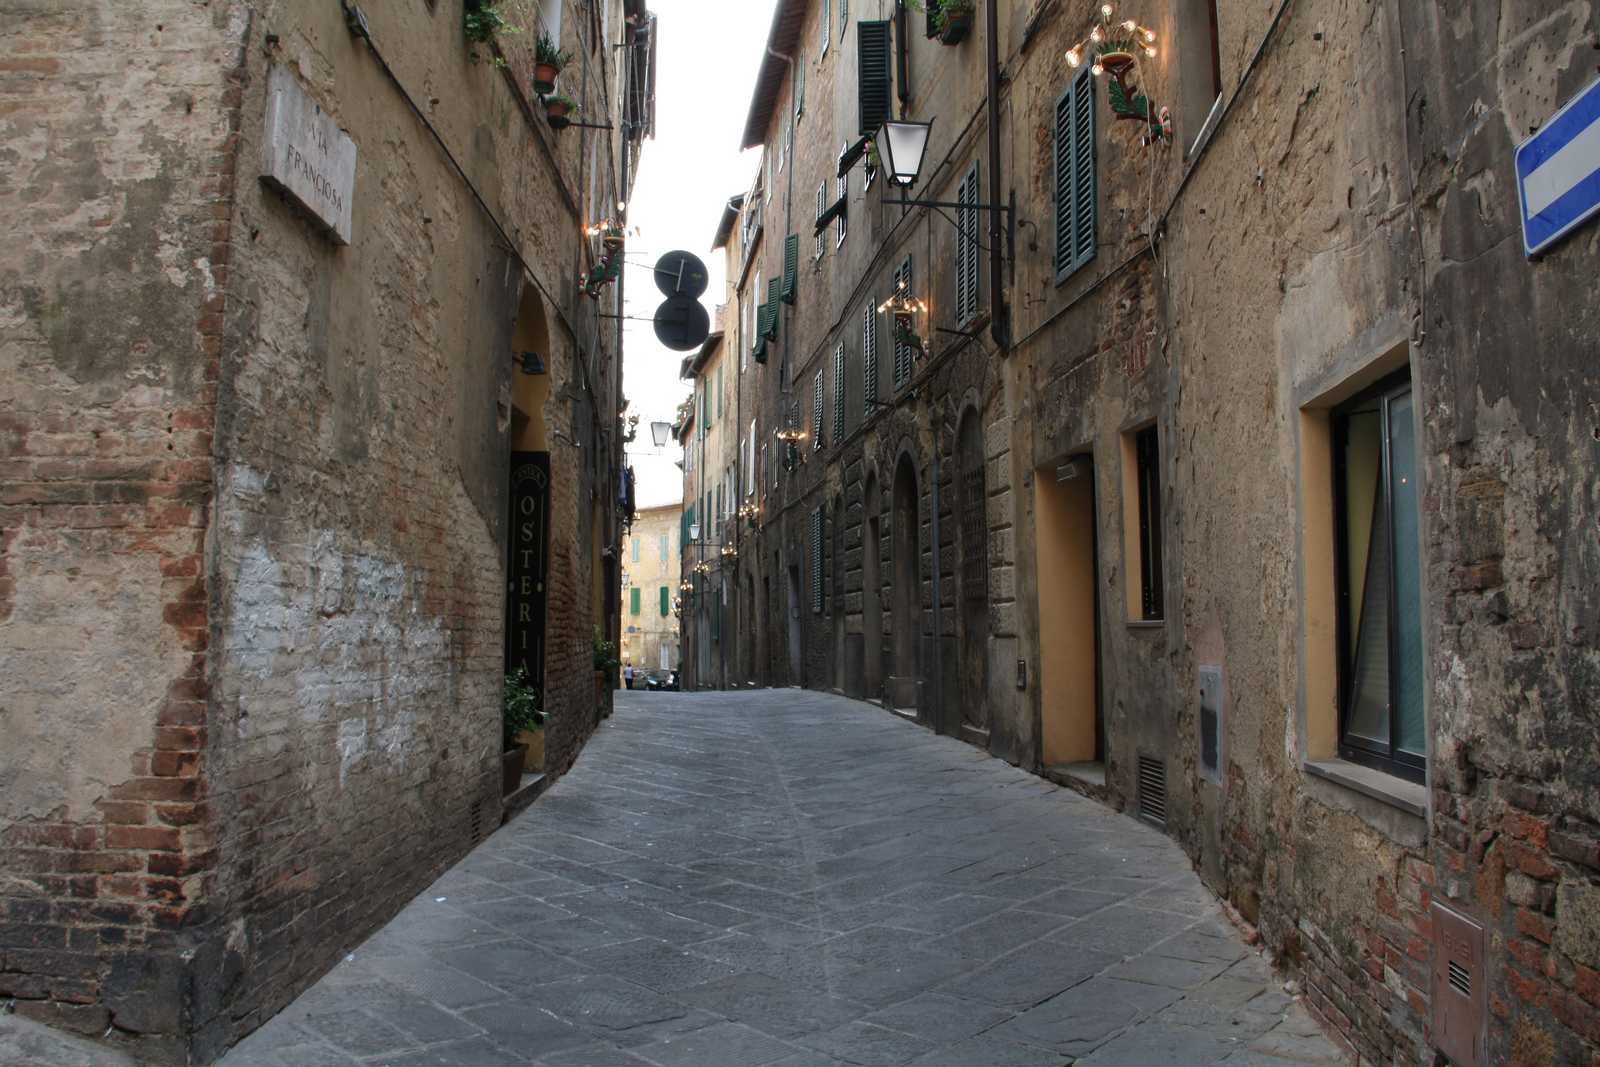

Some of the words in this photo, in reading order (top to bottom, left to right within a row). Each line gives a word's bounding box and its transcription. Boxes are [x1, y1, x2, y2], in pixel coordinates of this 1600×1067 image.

[310, 125, 329, 156] VIA
[287, 144, 343, 212] FRANCIOSA
[518, 495, 536, 677] OSTERIA
